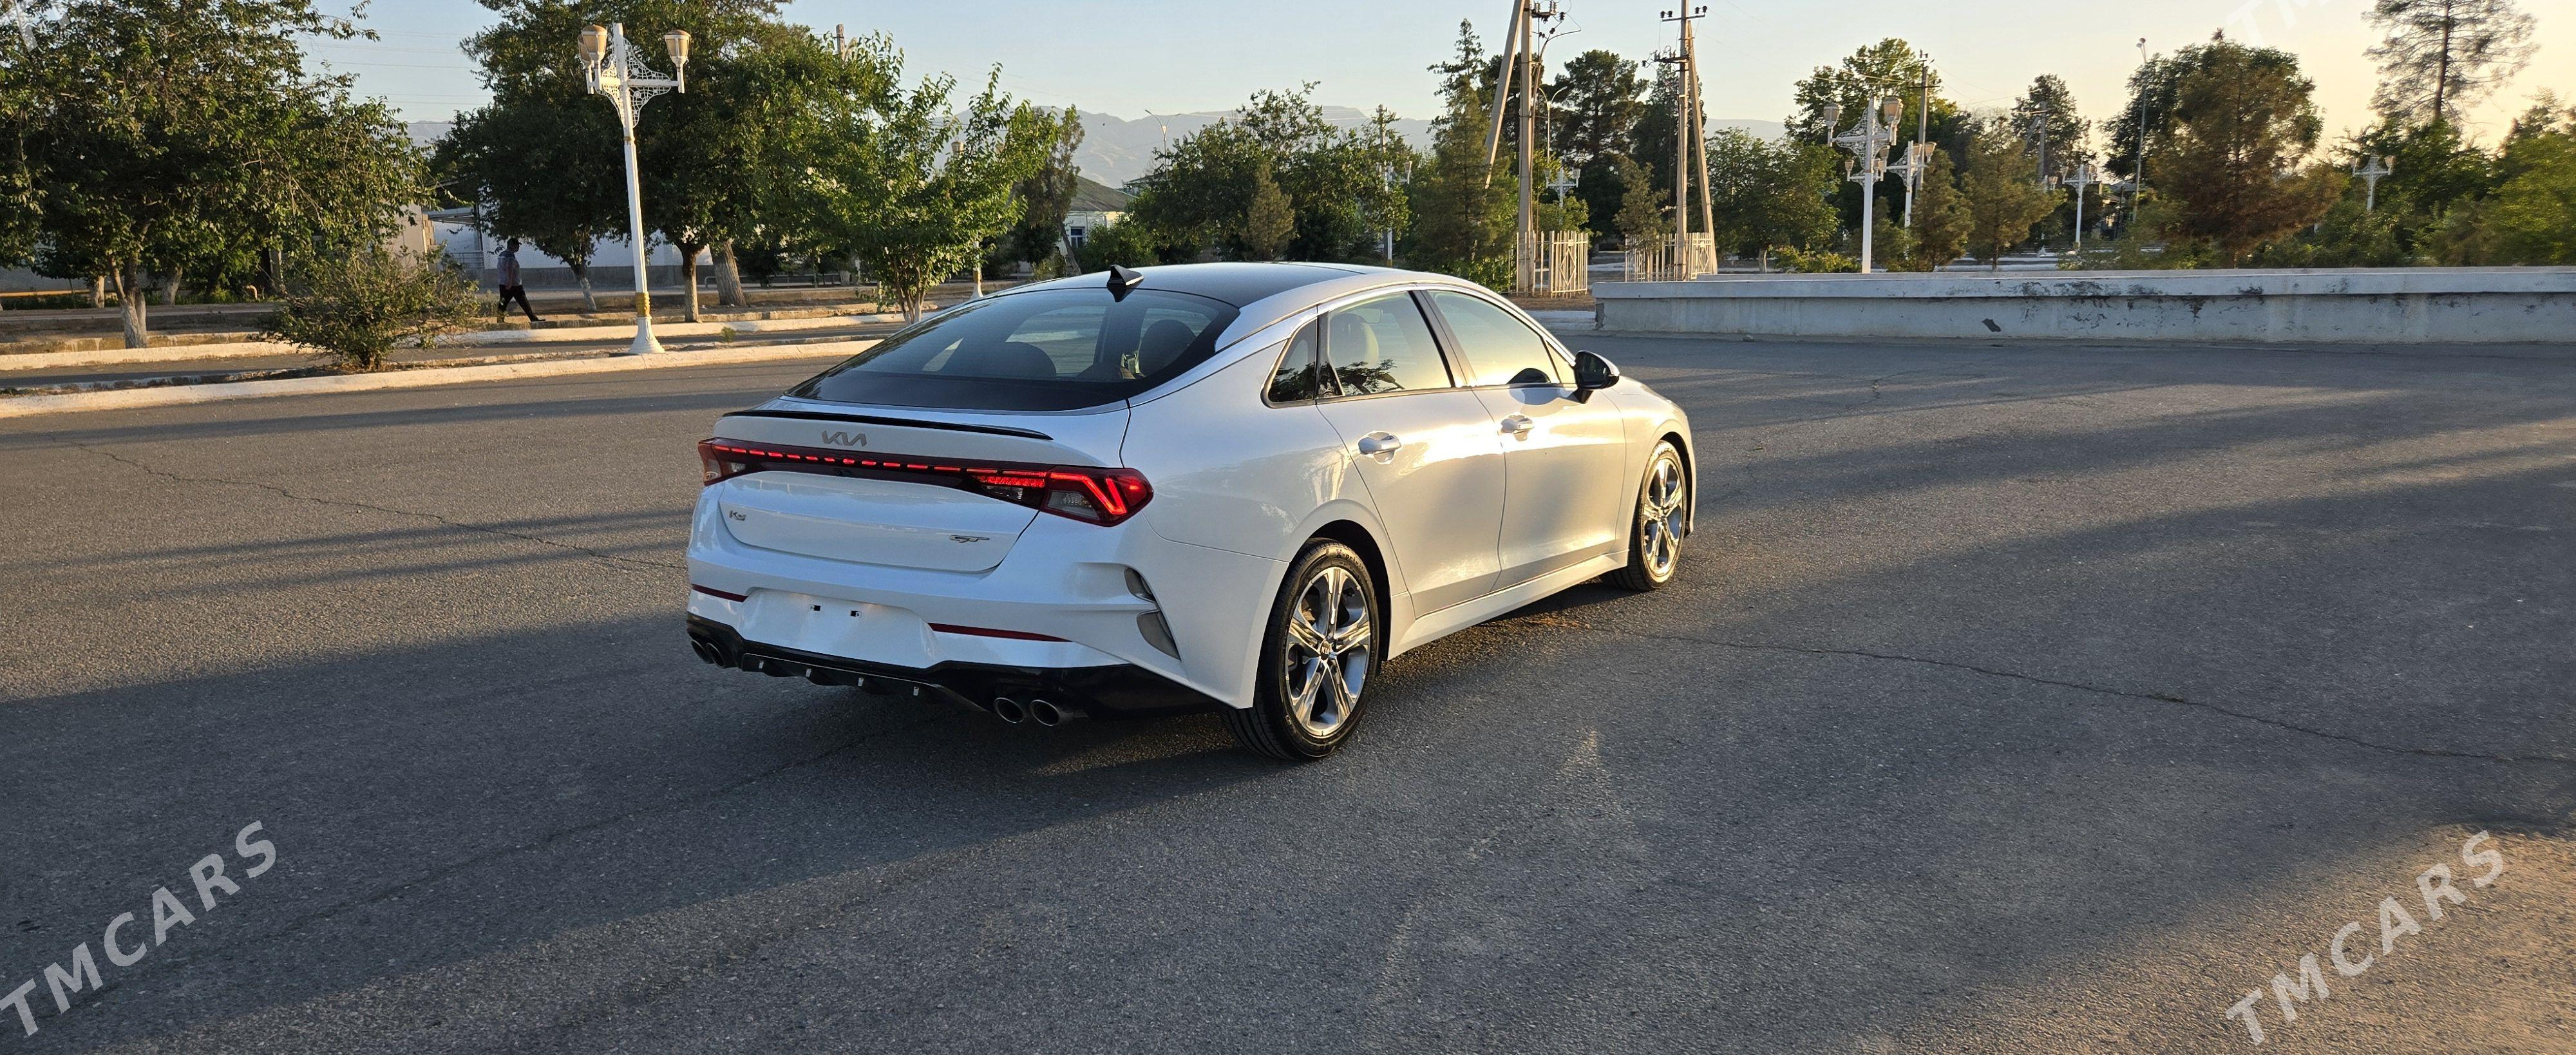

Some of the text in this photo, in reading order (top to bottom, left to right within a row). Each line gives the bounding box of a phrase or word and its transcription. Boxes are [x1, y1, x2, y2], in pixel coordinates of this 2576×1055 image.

[821, 430, 867, 447] KIA
[729, 510, 747, 521] K5
[949, 535, 990, 544] GT
